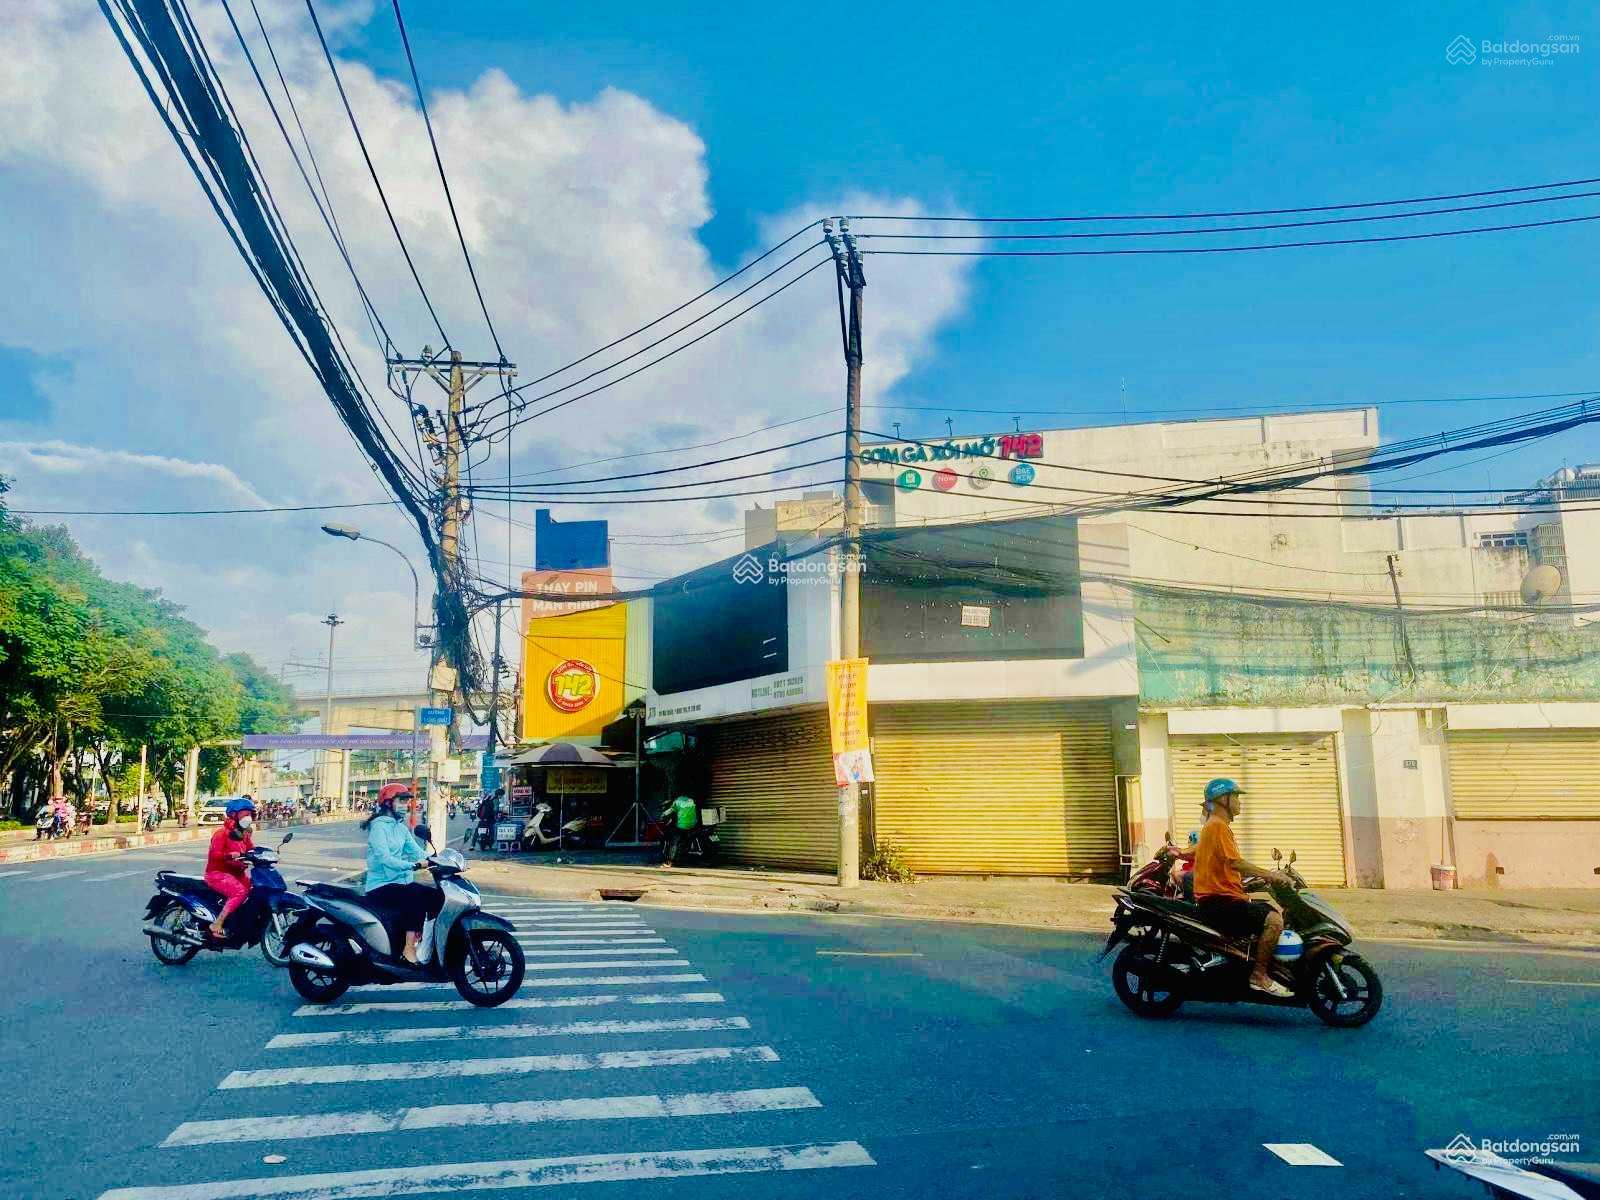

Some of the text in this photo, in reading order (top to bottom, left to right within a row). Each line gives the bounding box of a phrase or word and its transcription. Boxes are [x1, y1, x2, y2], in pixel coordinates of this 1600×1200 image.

[998, 432, 1042, 460] 142
[535, 580, 598, 593] THAY PIN
[554, 674, 592, 697] 142
